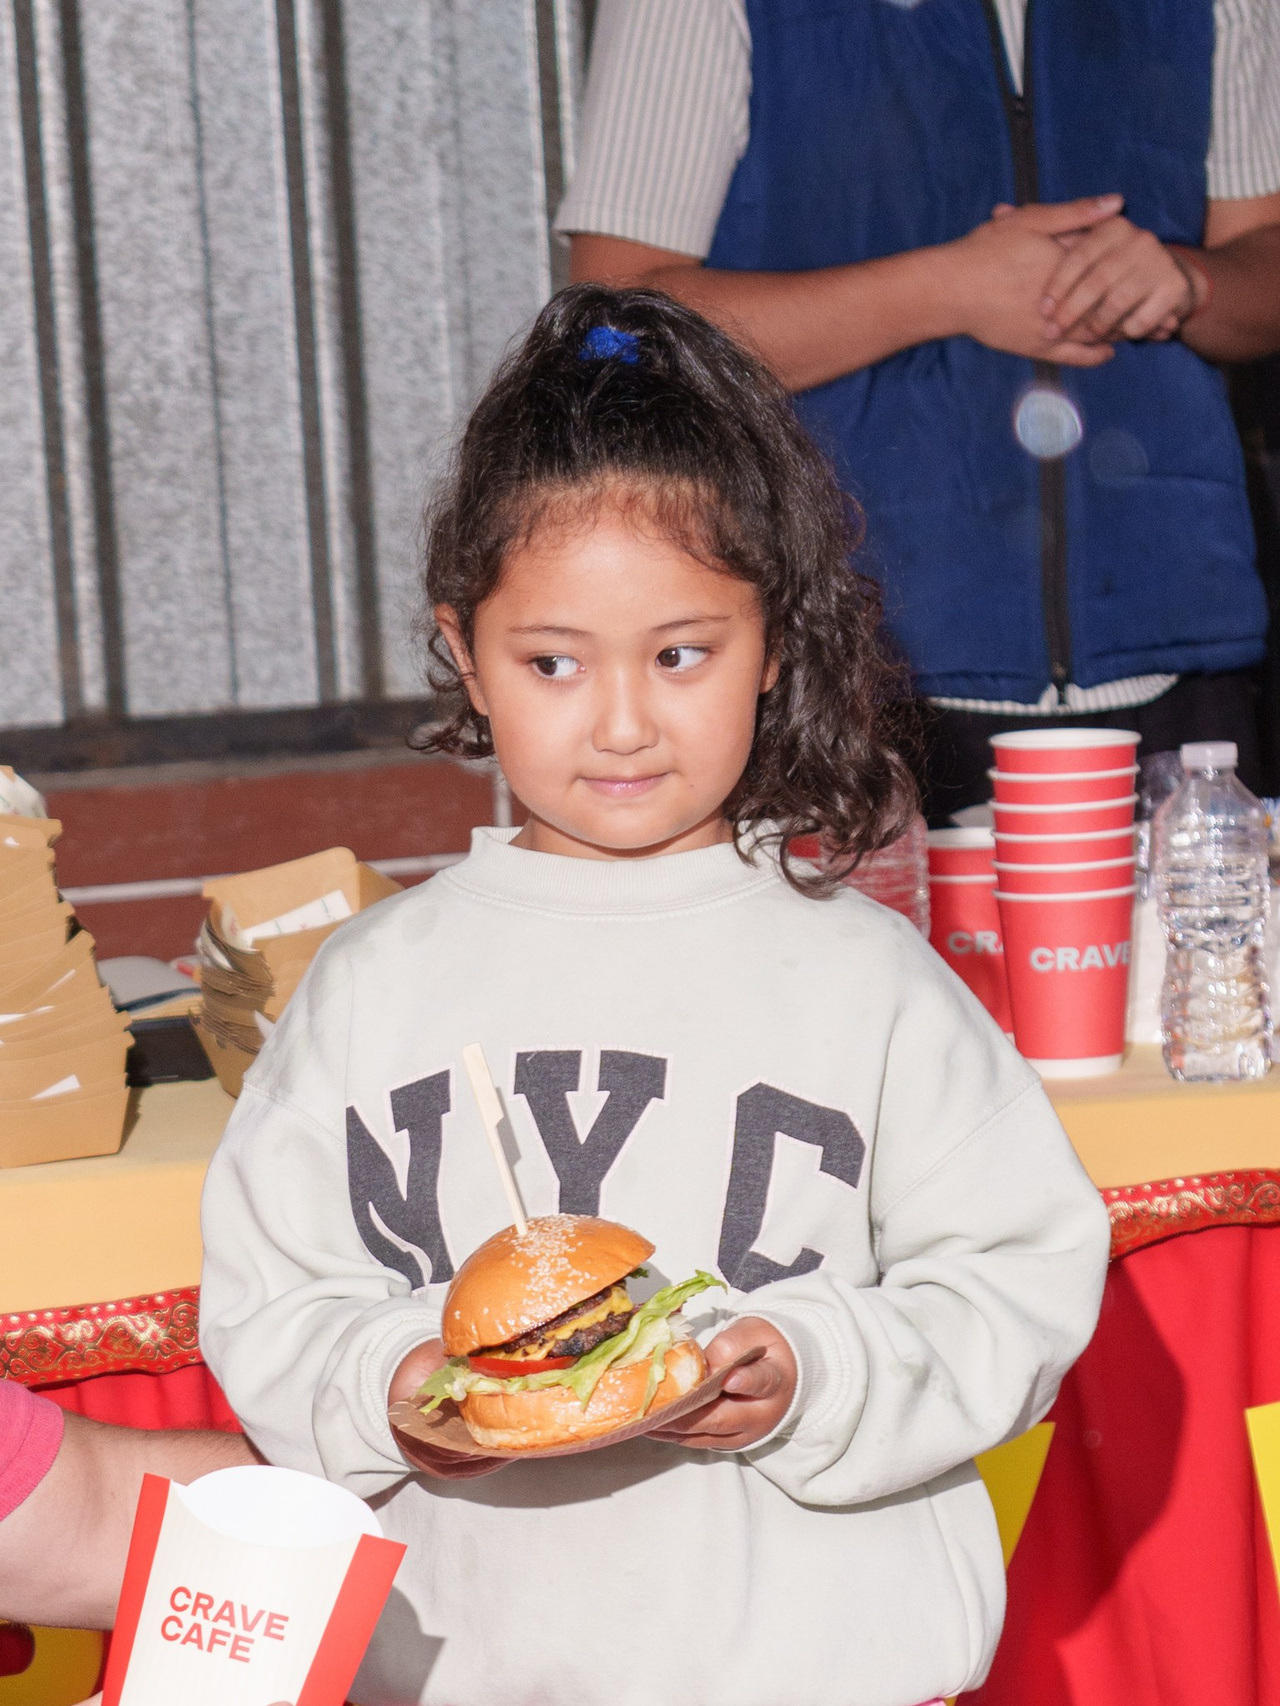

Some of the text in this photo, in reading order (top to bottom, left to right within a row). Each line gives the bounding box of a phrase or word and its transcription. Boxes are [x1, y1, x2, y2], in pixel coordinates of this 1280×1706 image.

[345, 1048, 868, 1292] NYC
[160, 1614, 255, 1664] CAFE
[169, 1585, 290, 1641] CRAVE
